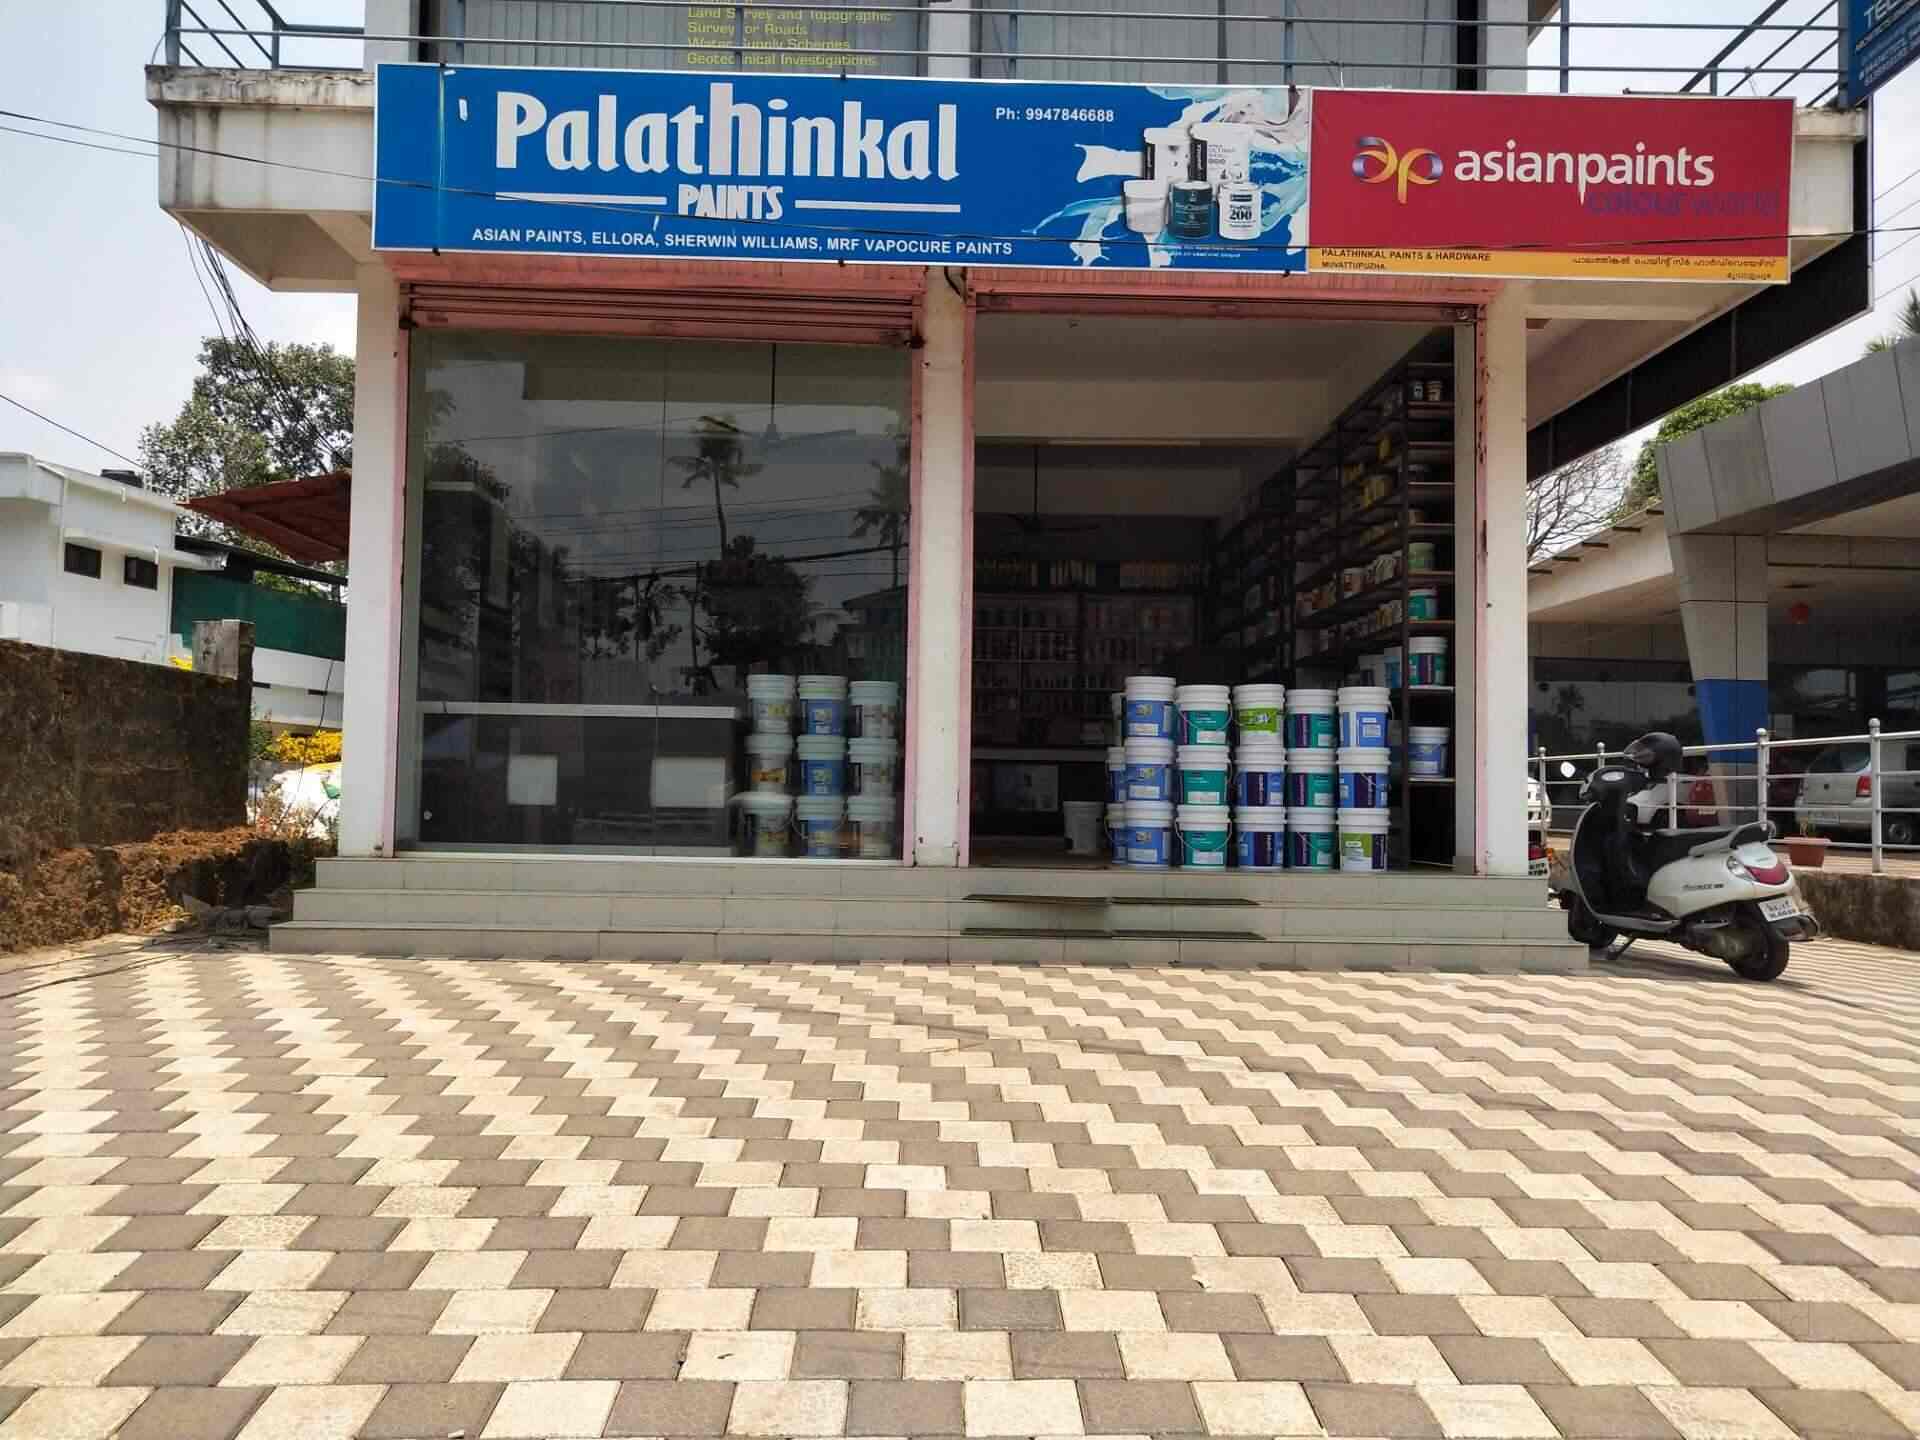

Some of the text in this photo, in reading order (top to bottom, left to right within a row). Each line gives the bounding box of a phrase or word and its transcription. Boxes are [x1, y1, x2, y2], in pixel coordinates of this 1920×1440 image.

[687, 7, 721, 19] Land
[726, 8, 770, 21] Srvey
[777, 9, 802, 20] and
[687, 23, 735, 34] Survey
[764, 24, 808, 35] Roads
[687, 52, 880, 68] Geotecnical Investigations
[995, 107, 1115, 122] Ph: 9947846688
[496, 82, 961, 182] Palathinkal
[1454, 139, 1715, 205] asianpaints
[678, 184, 784, 221] PAINTS
[471, 228, 1013, 255] ASIAN PAINTS, ELLORA, SHERWIN WILLIAMS, MRF VAPOCURE PAINTS
[1321, 248, 1492, 262] PALATHINKAL PAINTS & HARDWARE
